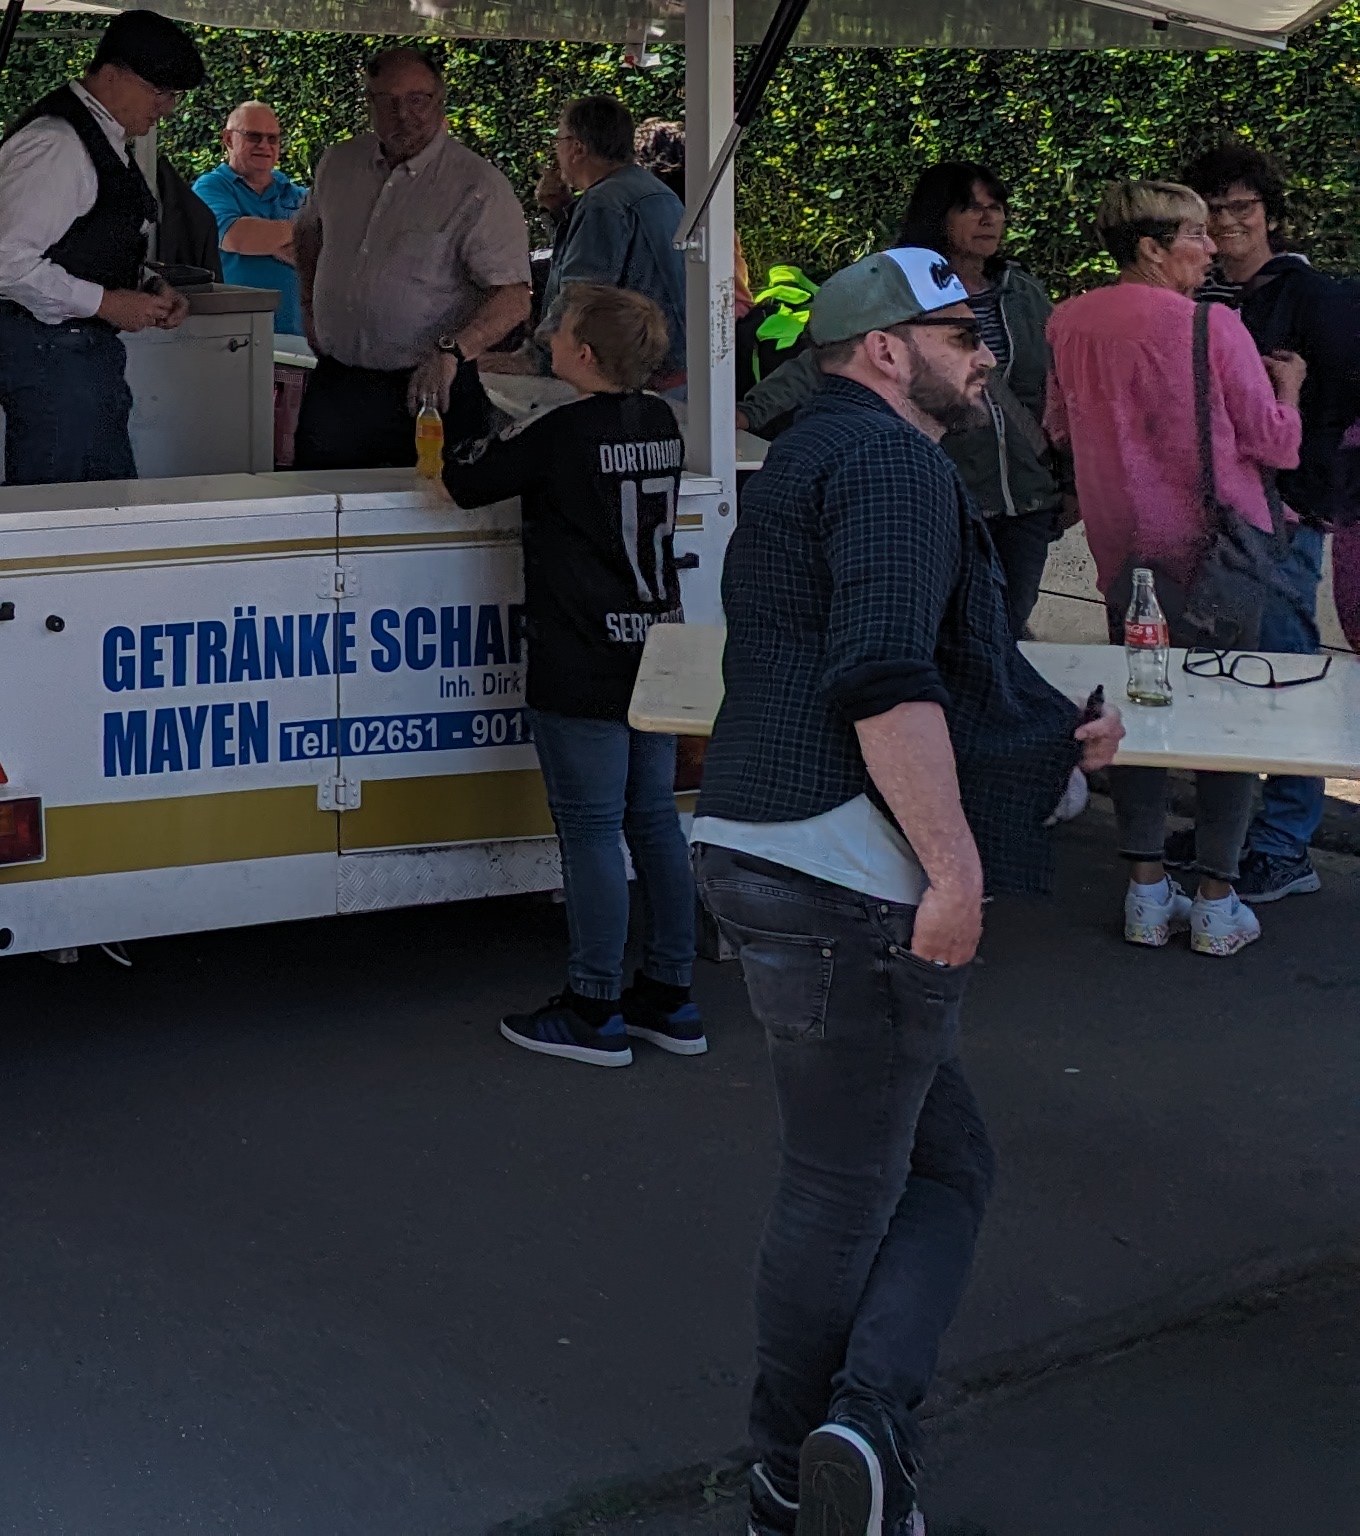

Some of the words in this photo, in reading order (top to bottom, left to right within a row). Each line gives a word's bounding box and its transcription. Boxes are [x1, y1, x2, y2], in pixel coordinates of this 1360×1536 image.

[621, 475, 675, 602] 17
[102, 605, 357, 693] GETRÄNKE
[439, 674, 476, 699] Inh.
[482, 671, 522, 696] Dirk
[103, 700, 269, 777] MAYEN
[284, 723, 338, 758] Tel.
[349, 717, 438, 754] 02651
[471, 711, 526, 745] 901
